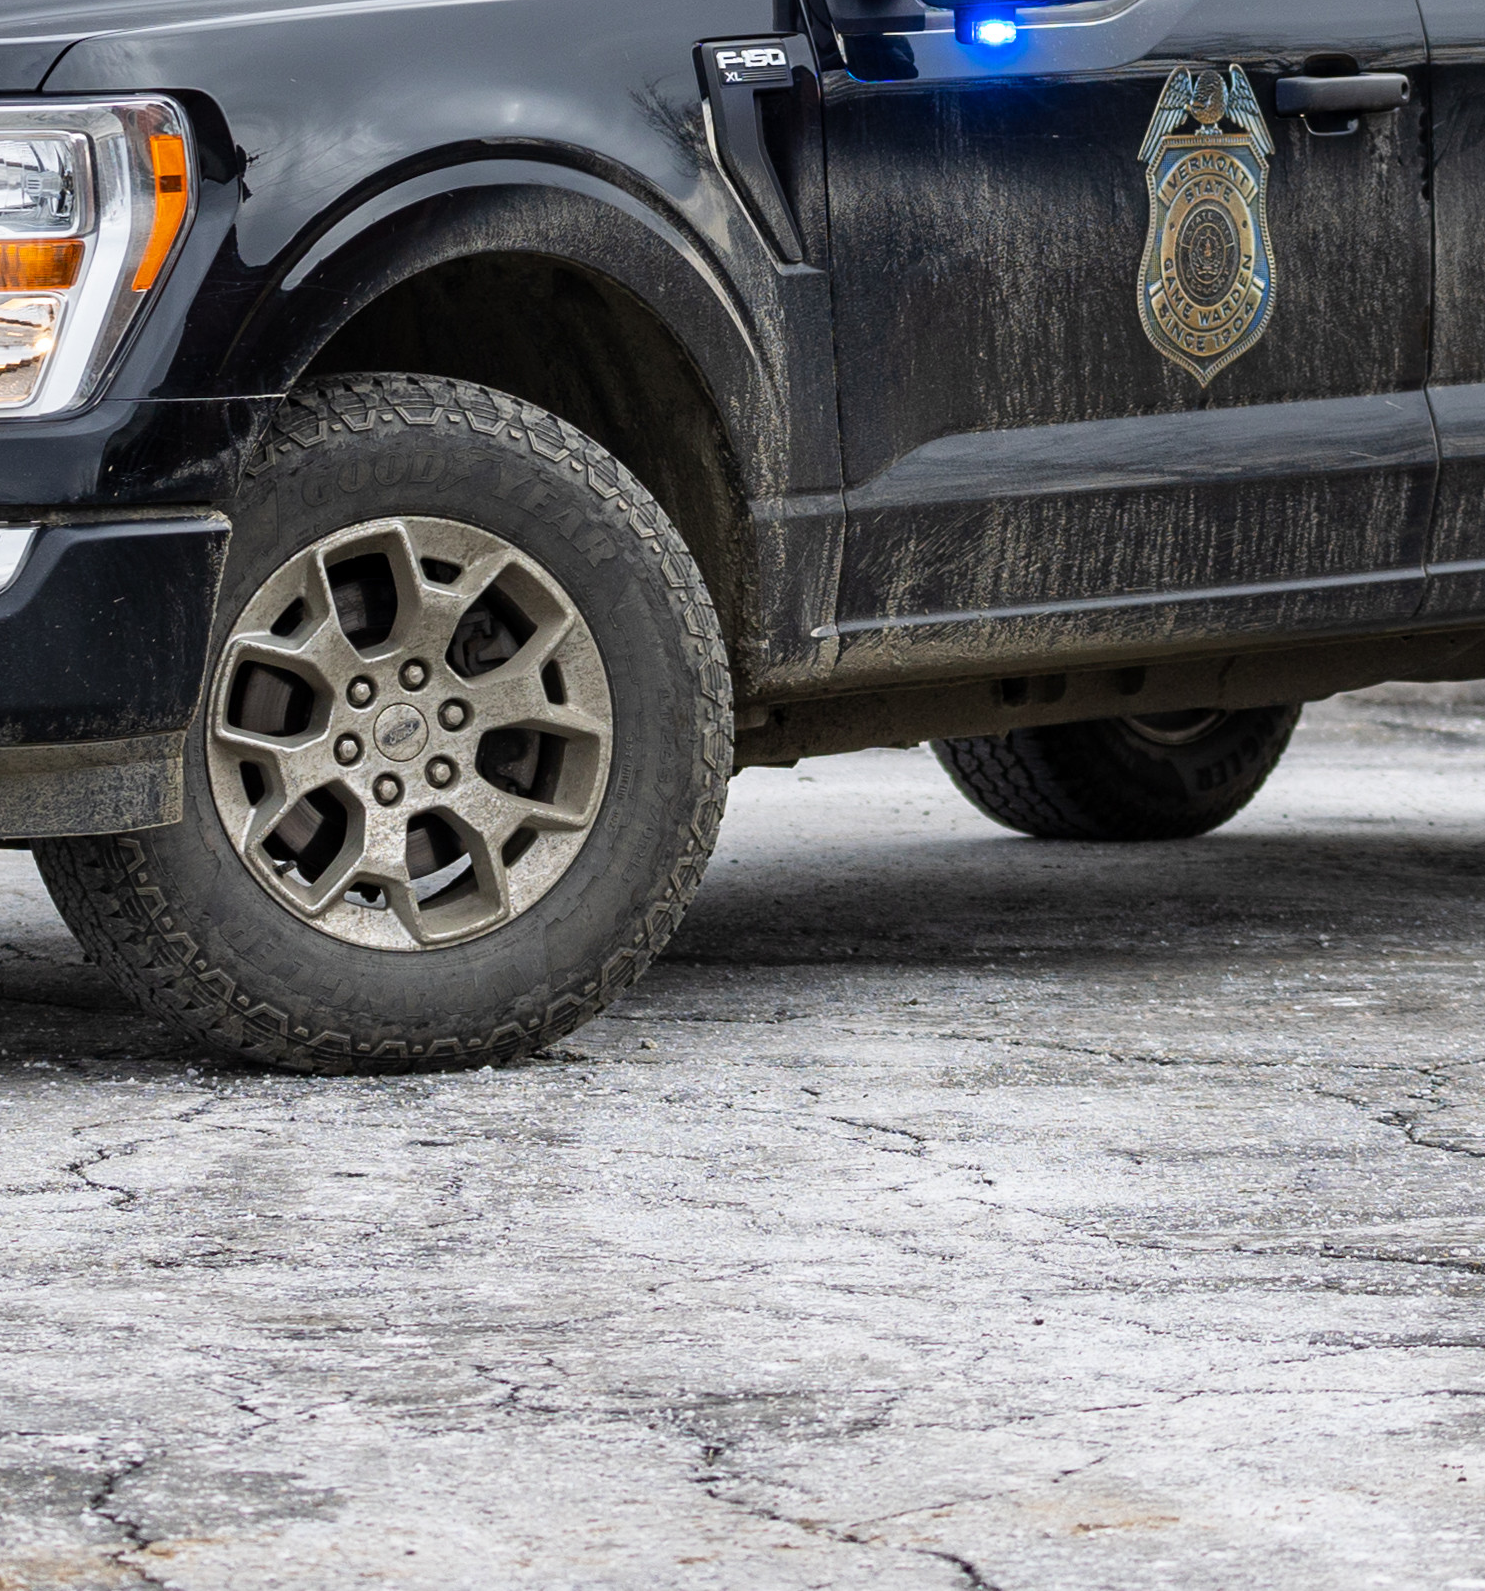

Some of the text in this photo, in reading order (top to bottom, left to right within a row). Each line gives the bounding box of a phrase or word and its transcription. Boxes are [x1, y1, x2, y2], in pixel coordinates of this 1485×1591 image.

[716, 48, 787, 69] F-150
[724, 71, 743, 83] XL
[1167, 154, 1250, 190] VERMONT
[1184, 180, 1234, 204] STATE
[1163, 253, 1253, 327] GAME WARDEN
[1158, 302, 1207, 353] SINCE
